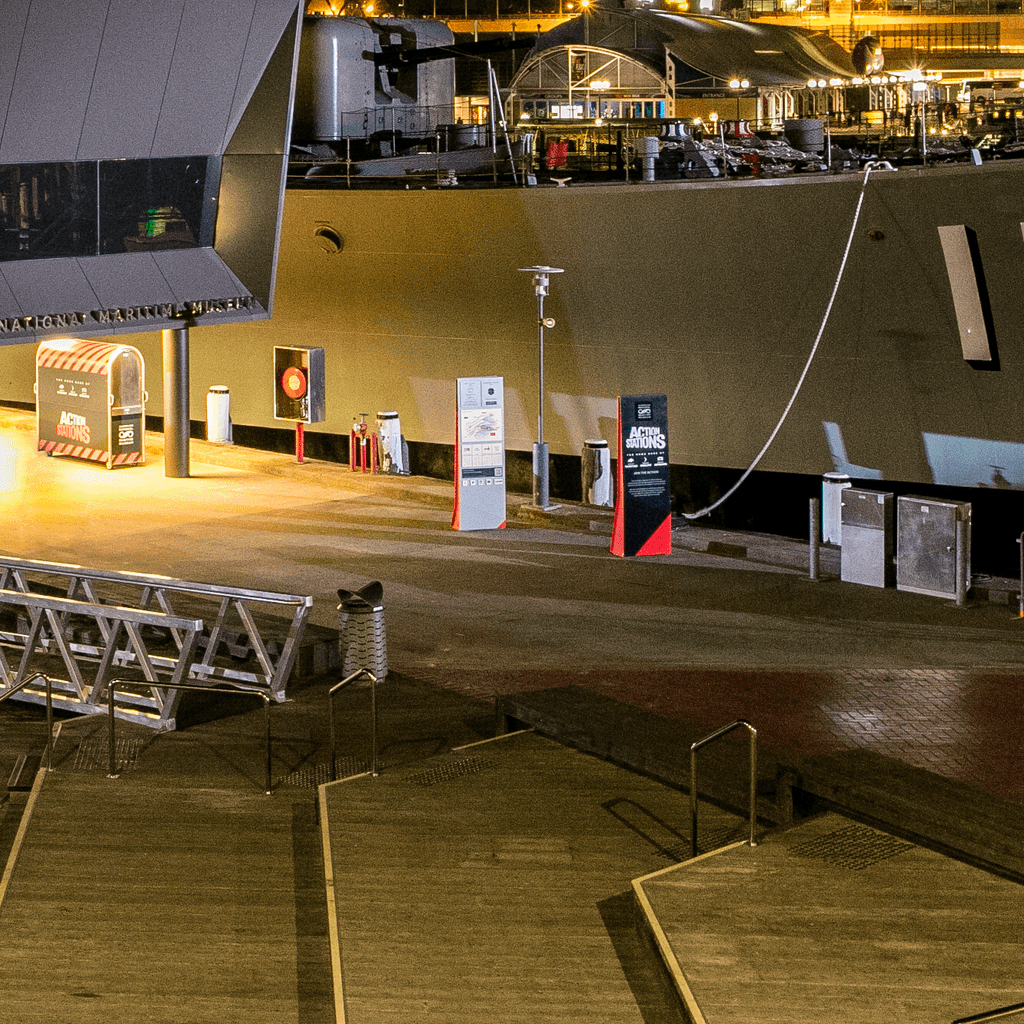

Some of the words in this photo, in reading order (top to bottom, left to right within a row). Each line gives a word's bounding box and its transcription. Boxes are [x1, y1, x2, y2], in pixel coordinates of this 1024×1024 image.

[99, 303, 181, 324] MARITIM
[59, 411, 86, 425] ACTION
[629, 426, 660, 438] ACTION
[626, 434, 666, 449] STATIONS
